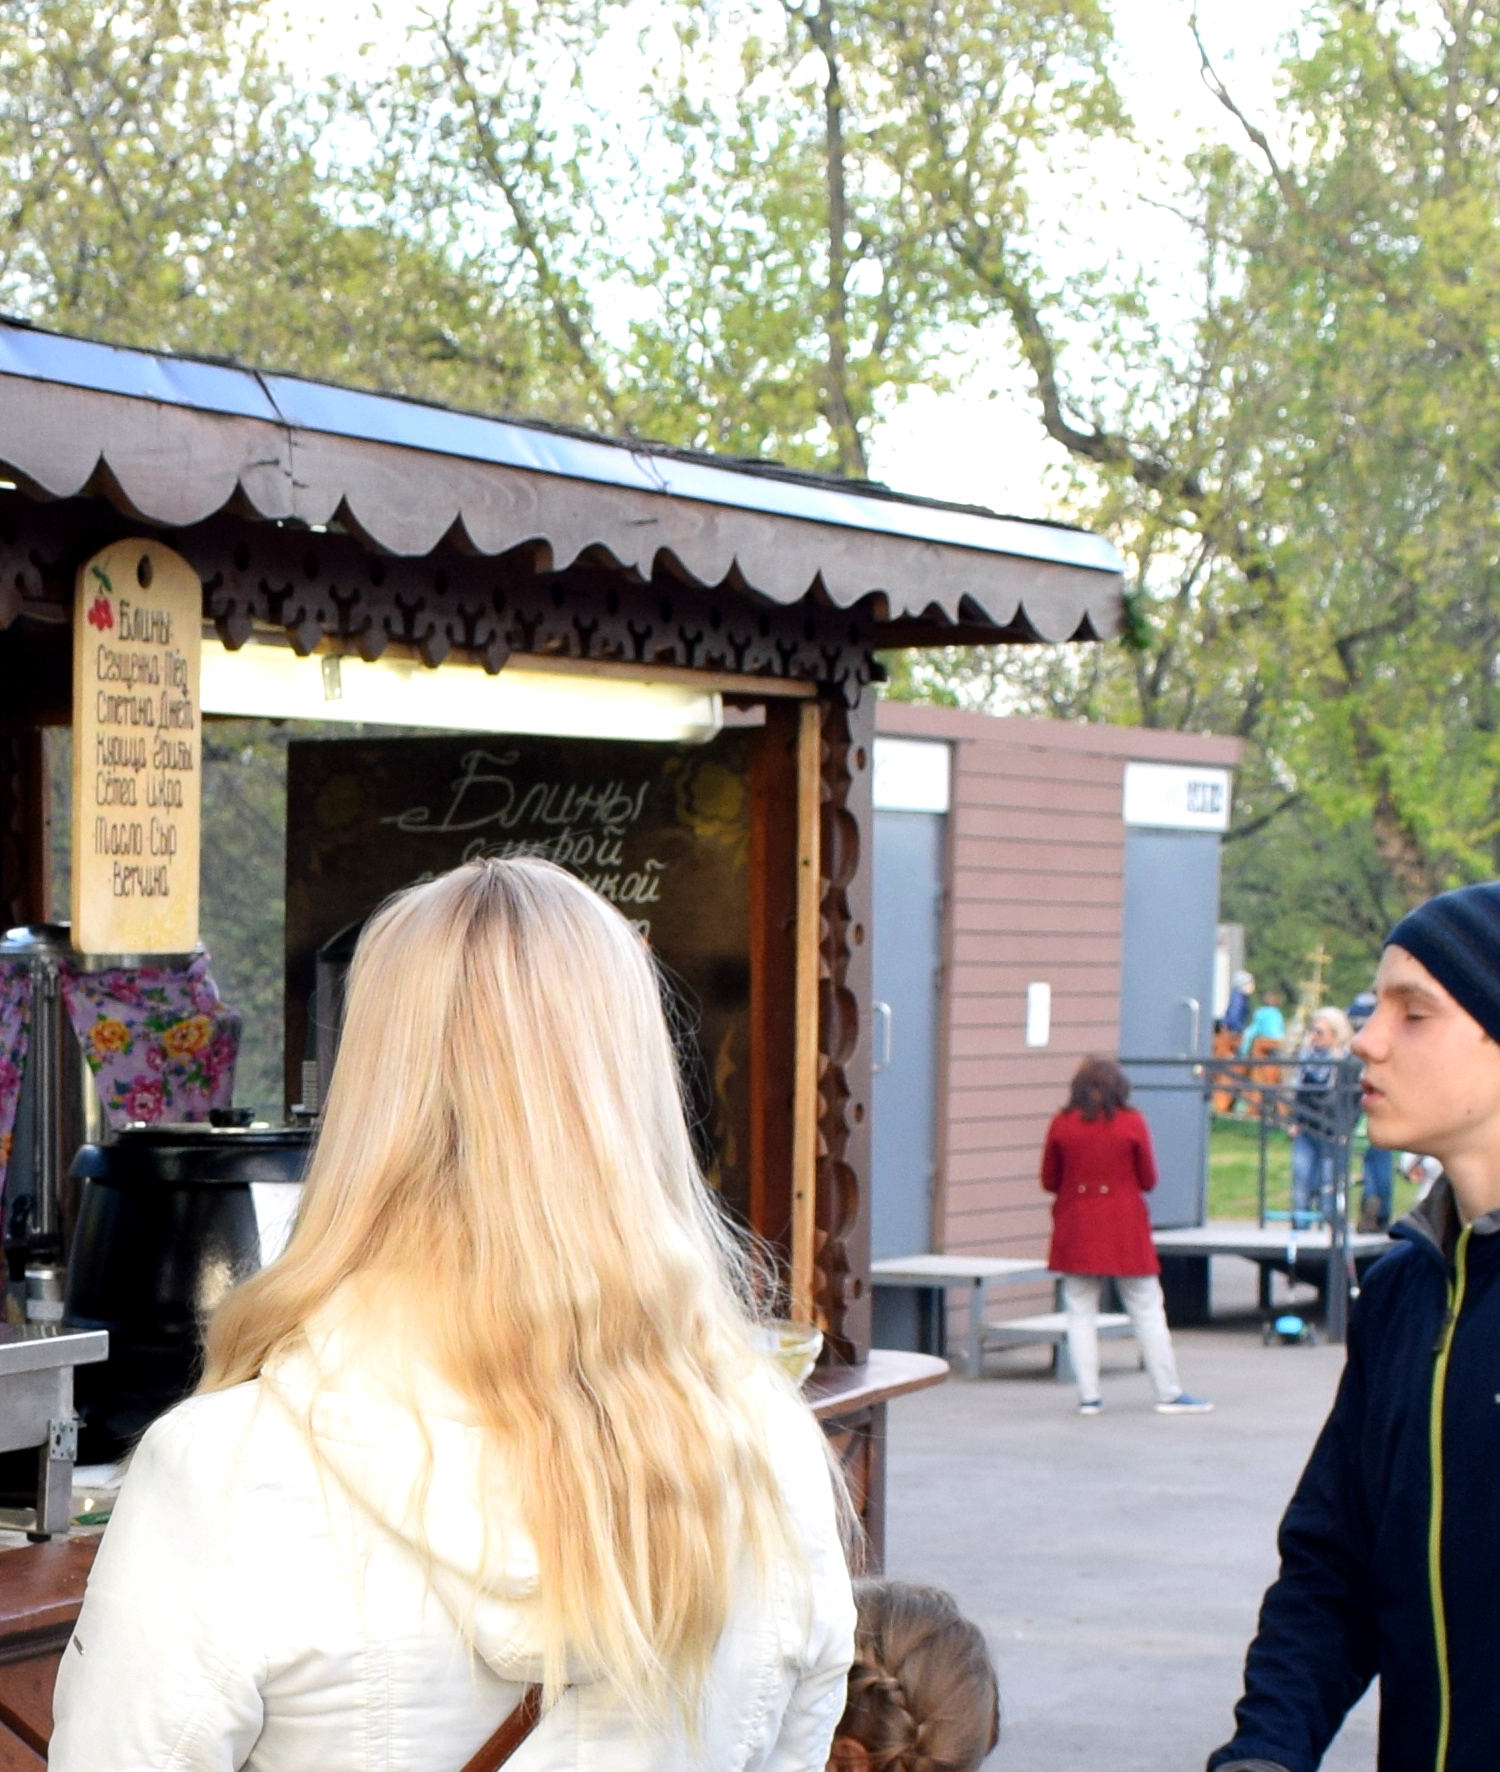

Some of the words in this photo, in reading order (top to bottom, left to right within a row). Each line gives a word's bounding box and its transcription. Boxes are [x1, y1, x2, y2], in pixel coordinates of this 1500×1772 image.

[381, 750, 650, 832] Блины
[95, 816, 142, 855] Масло
[114, 861, 169, 896] Ветчина
